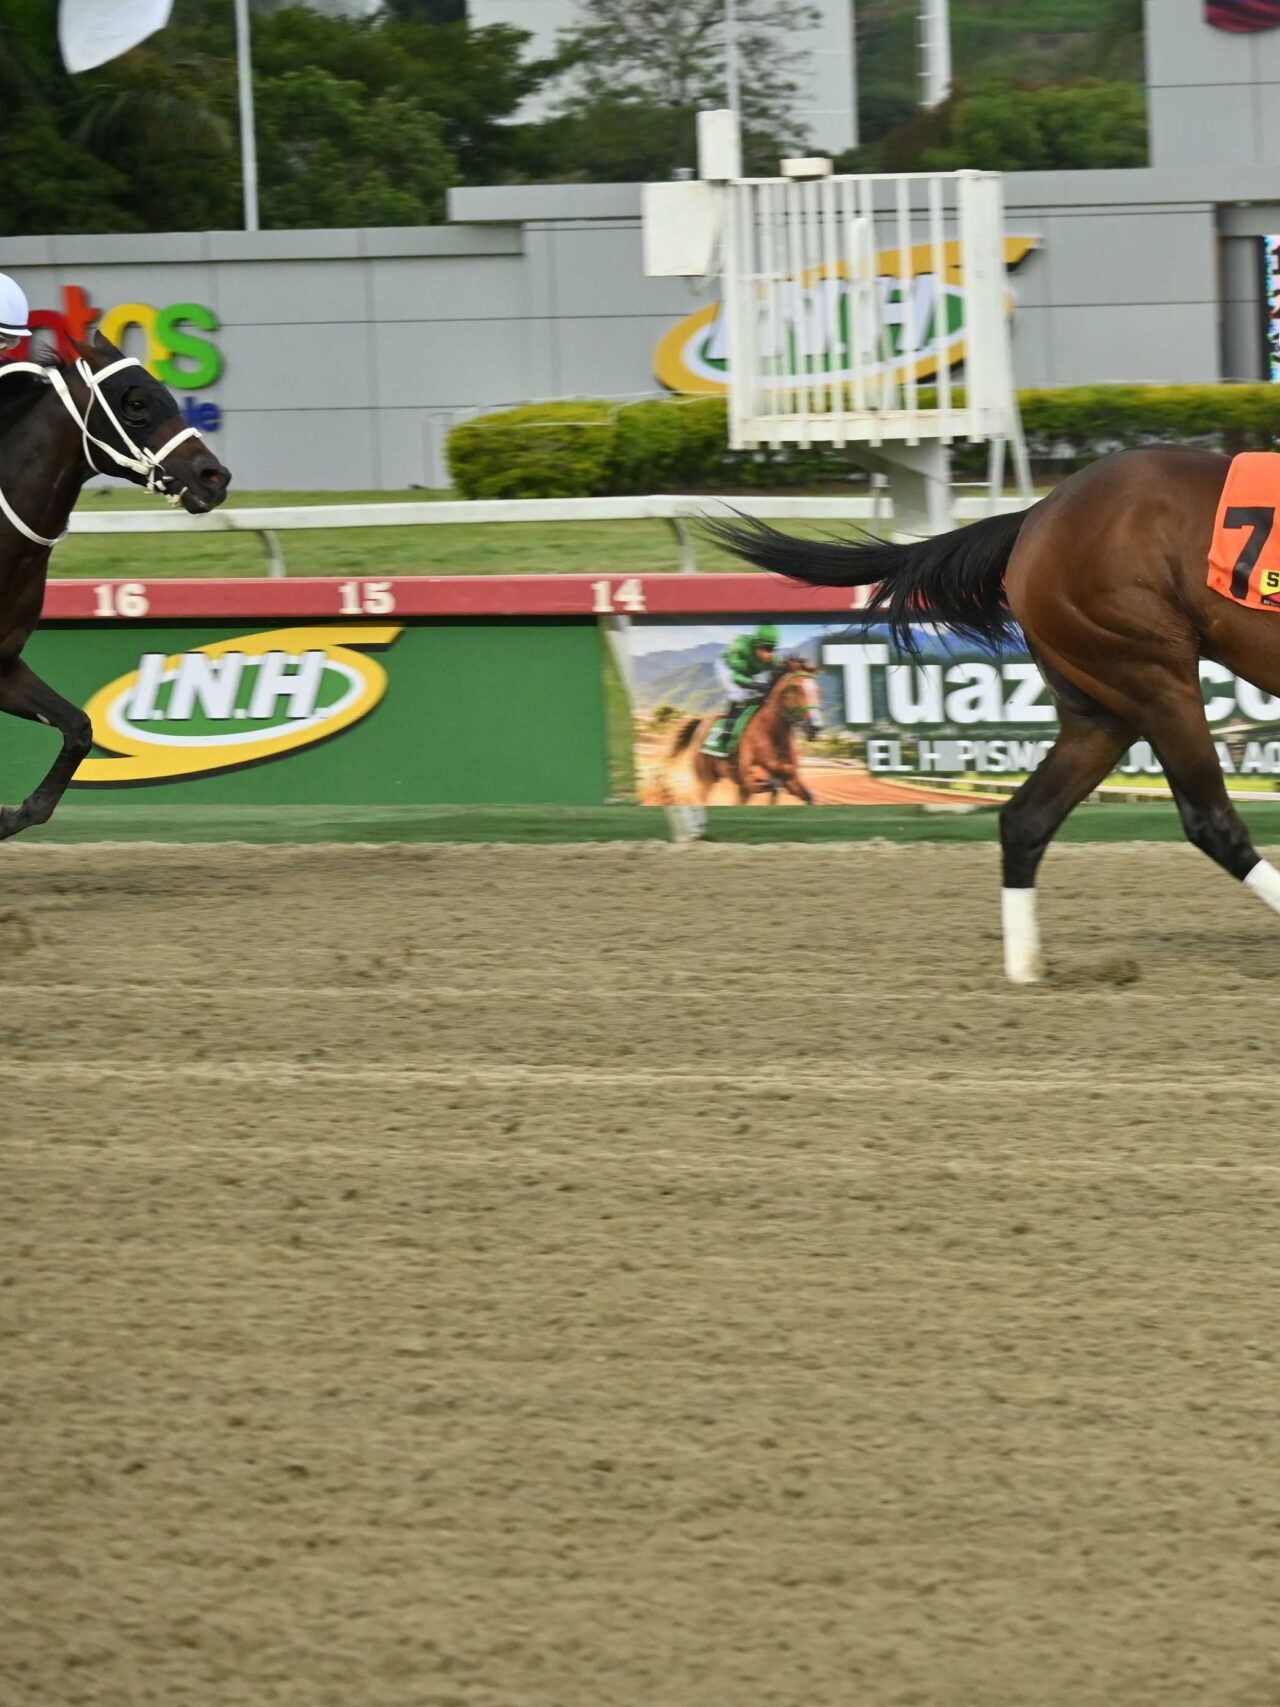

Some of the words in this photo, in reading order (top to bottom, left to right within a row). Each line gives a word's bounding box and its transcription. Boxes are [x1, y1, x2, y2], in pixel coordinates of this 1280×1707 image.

[1223, 507, 1276, 600] 7
[93, 583, 150, 617] 16
[338, 581, 397, 615] 15
[592, 578, 646, 613] 14
[867, 740, 914, 771] EL
